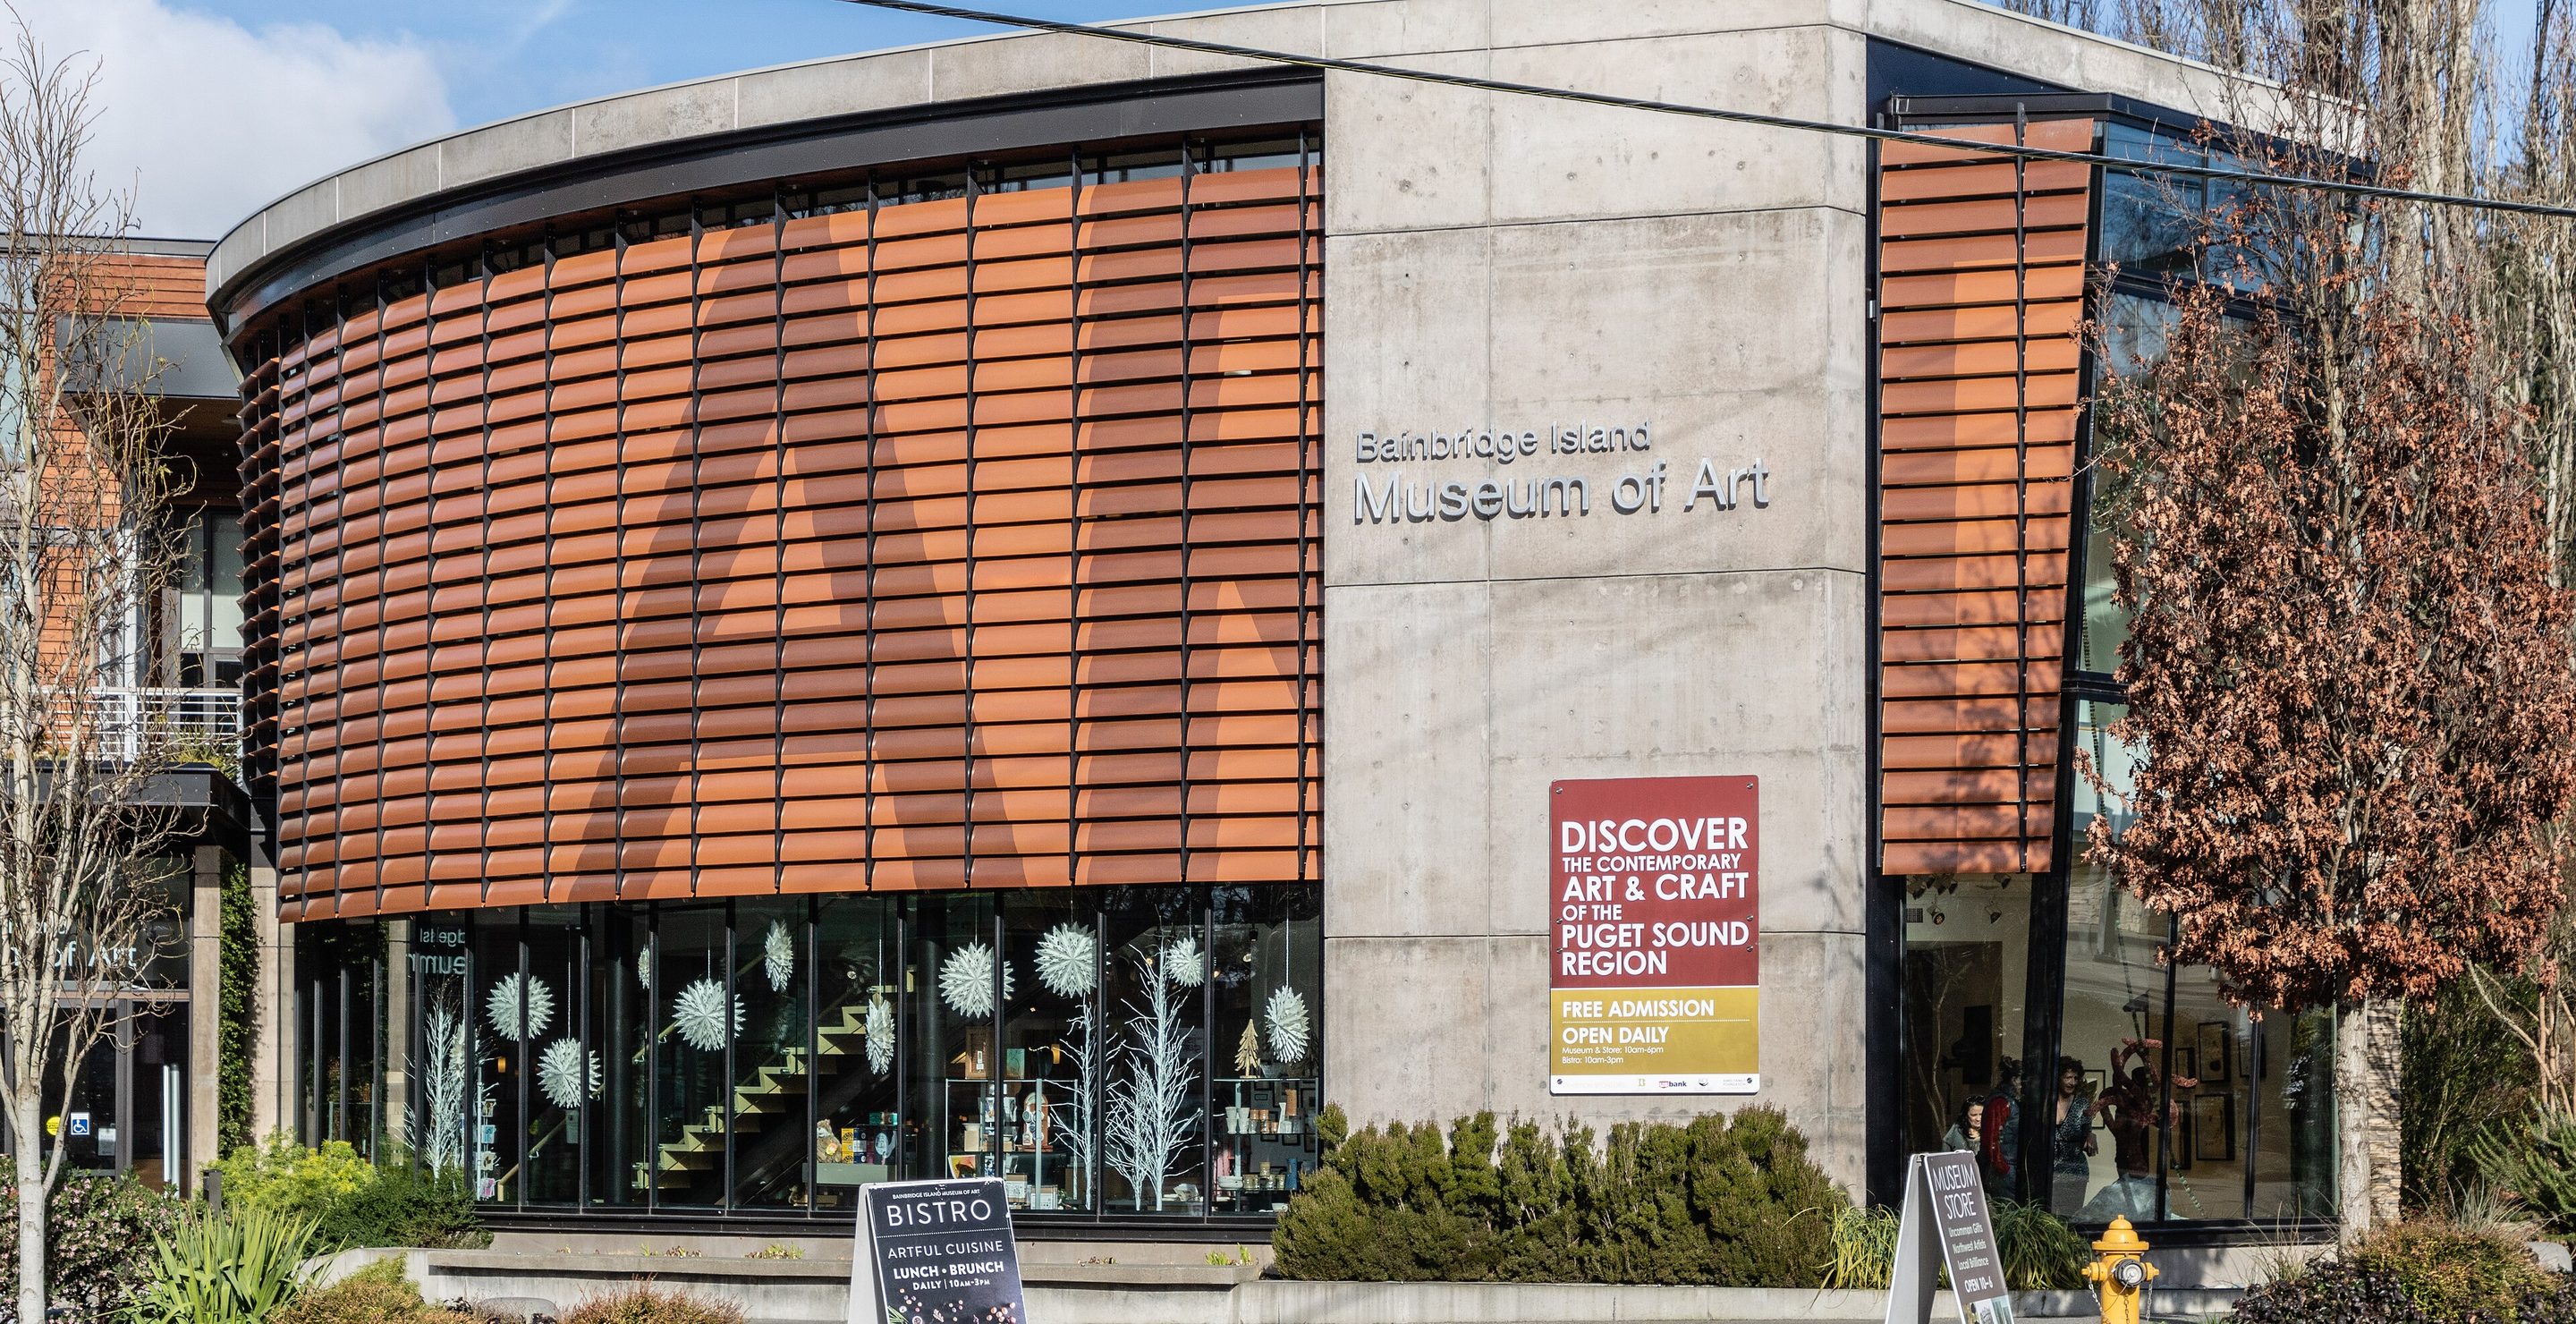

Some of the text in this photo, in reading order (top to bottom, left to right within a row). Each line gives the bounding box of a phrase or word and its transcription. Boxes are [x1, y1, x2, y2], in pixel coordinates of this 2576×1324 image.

[1356, 420, 1652, 463] Bainbridge Island
[1354, 457, 1769, 525] Museum of Art
[1562, 817, 1749, 853] DISCOVER
[1562, 853, 1741, 873] THE CONTEMPORARY
[1562, 872, 1750, 902] ART & CRAFT
[1562, 904, 1623, 921] OF THE
[1562, 921, 1750, 949] PUGET SOUND
[1562, 950, 1667, 976] REGION
[1562, 999, 1715, 1018] FREE ADMISSION
[1562, 1026, 1670, 1045] OPEN DAILY
[1562, 1045, 1664, 1055] Museum & Store: 10am-6pm
[1584, 1056, 1624, 1065] 10am-3pm
[1933, 1163, 1978, 1192] MUSEUM
[892, 1192, 923, 1200] BAINBRIDGE
[886, 1200, 991, 1226] BISTRO
[1944, 1192, 1977, 1220] STORE
[1948, 1222, 1984, 1238] Uncommon Gifts
[887, 1241, 1004, 1260] ARTFUL CUISINE
[1952, 1238, 1987, 1254] Northwest Artists
[893, 1261, 1004, 1279] LUNCH BRUNCH
[1957, 1256, 1989, 1270] Local Brilliance
[912, 1277, 991, 1291] DAILY 10AM-3PM
[1964, 1278, 1979, 1294] OPEN
